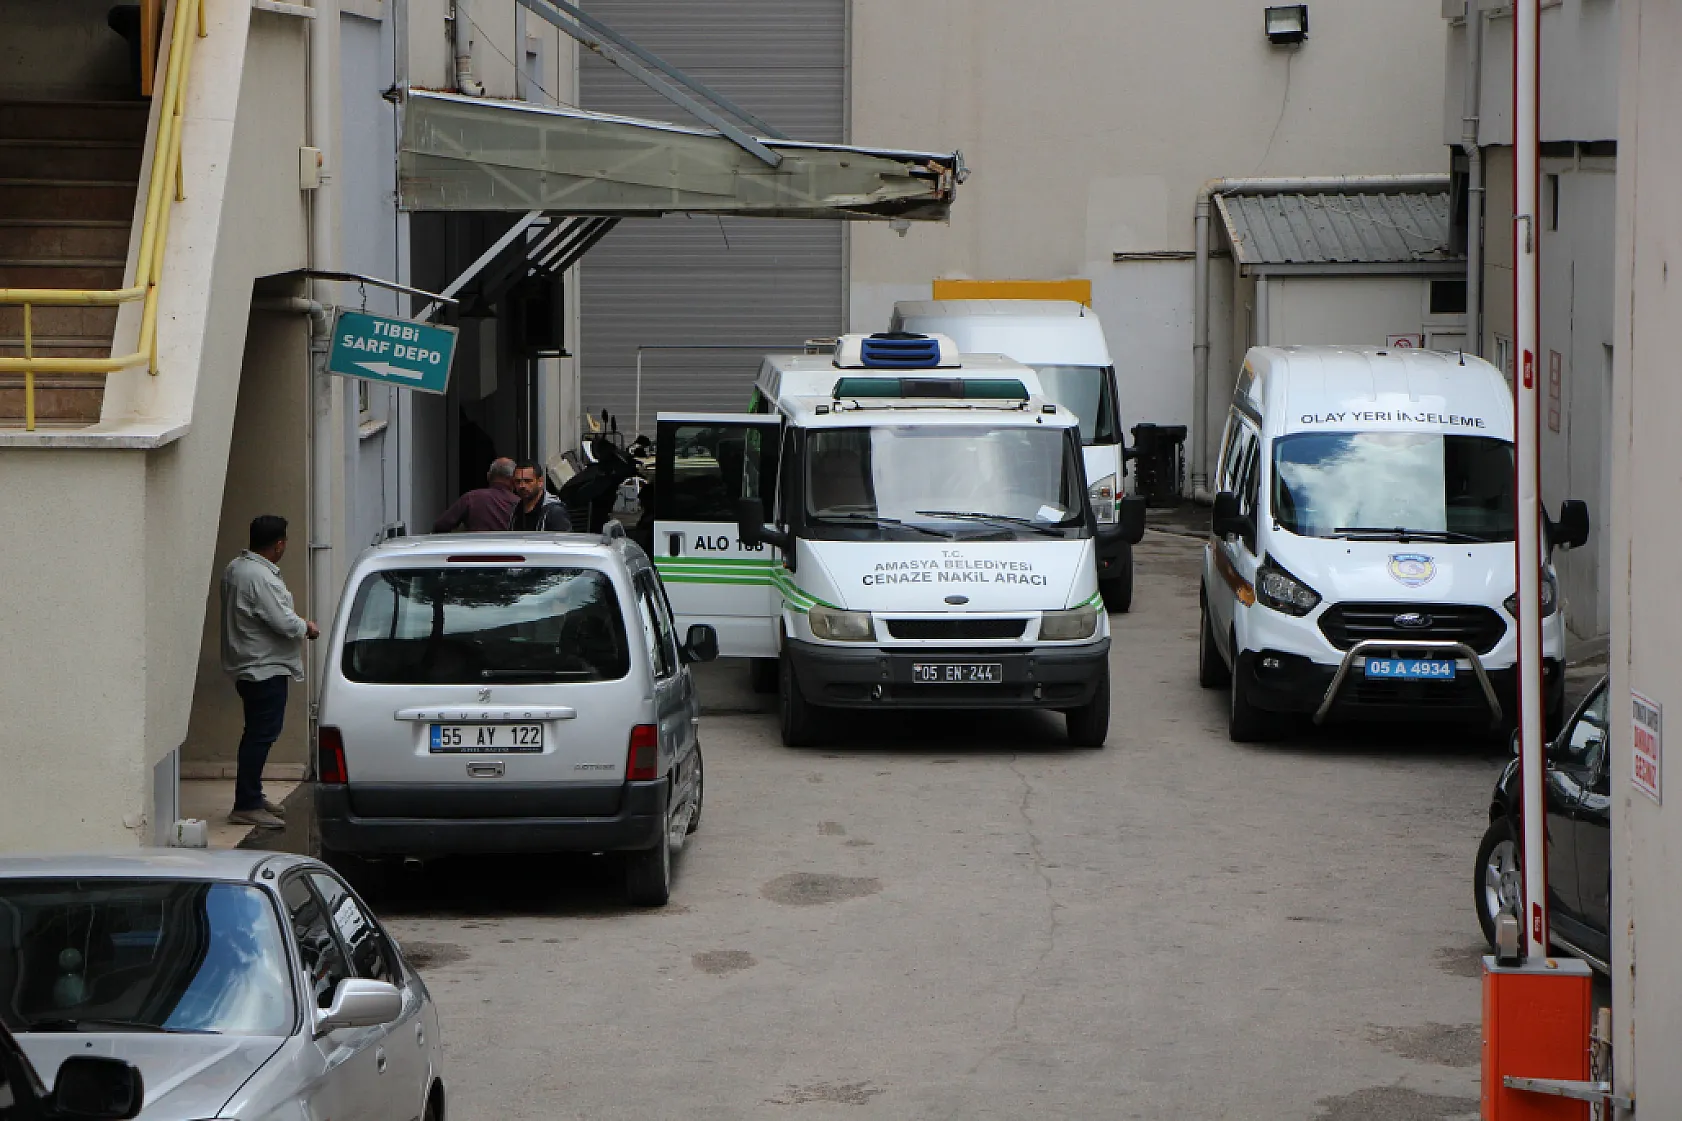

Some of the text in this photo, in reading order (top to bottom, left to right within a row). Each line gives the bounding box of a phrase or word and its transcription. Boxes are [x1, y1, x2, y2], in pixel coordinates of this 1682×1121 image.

[342, 334, 441, 365] SARF DEPO
[1301, 411, 1346, 424] OLAY
[694, 535, 730, 551] ALO
[874, 559, 939, 571] AMASYA
[862, 571, 933, 586] CENAZE
[994, 572, 1047, 586] ARACI
[922, 666, 938, 680] 05
[970, 666, 993, 681] 244
[1370, 660, 1450, 676] 05 A 4934
[418, 712, 552, 720] PEUGEOT
[442, 727, 540, 746] 55 AY 122
